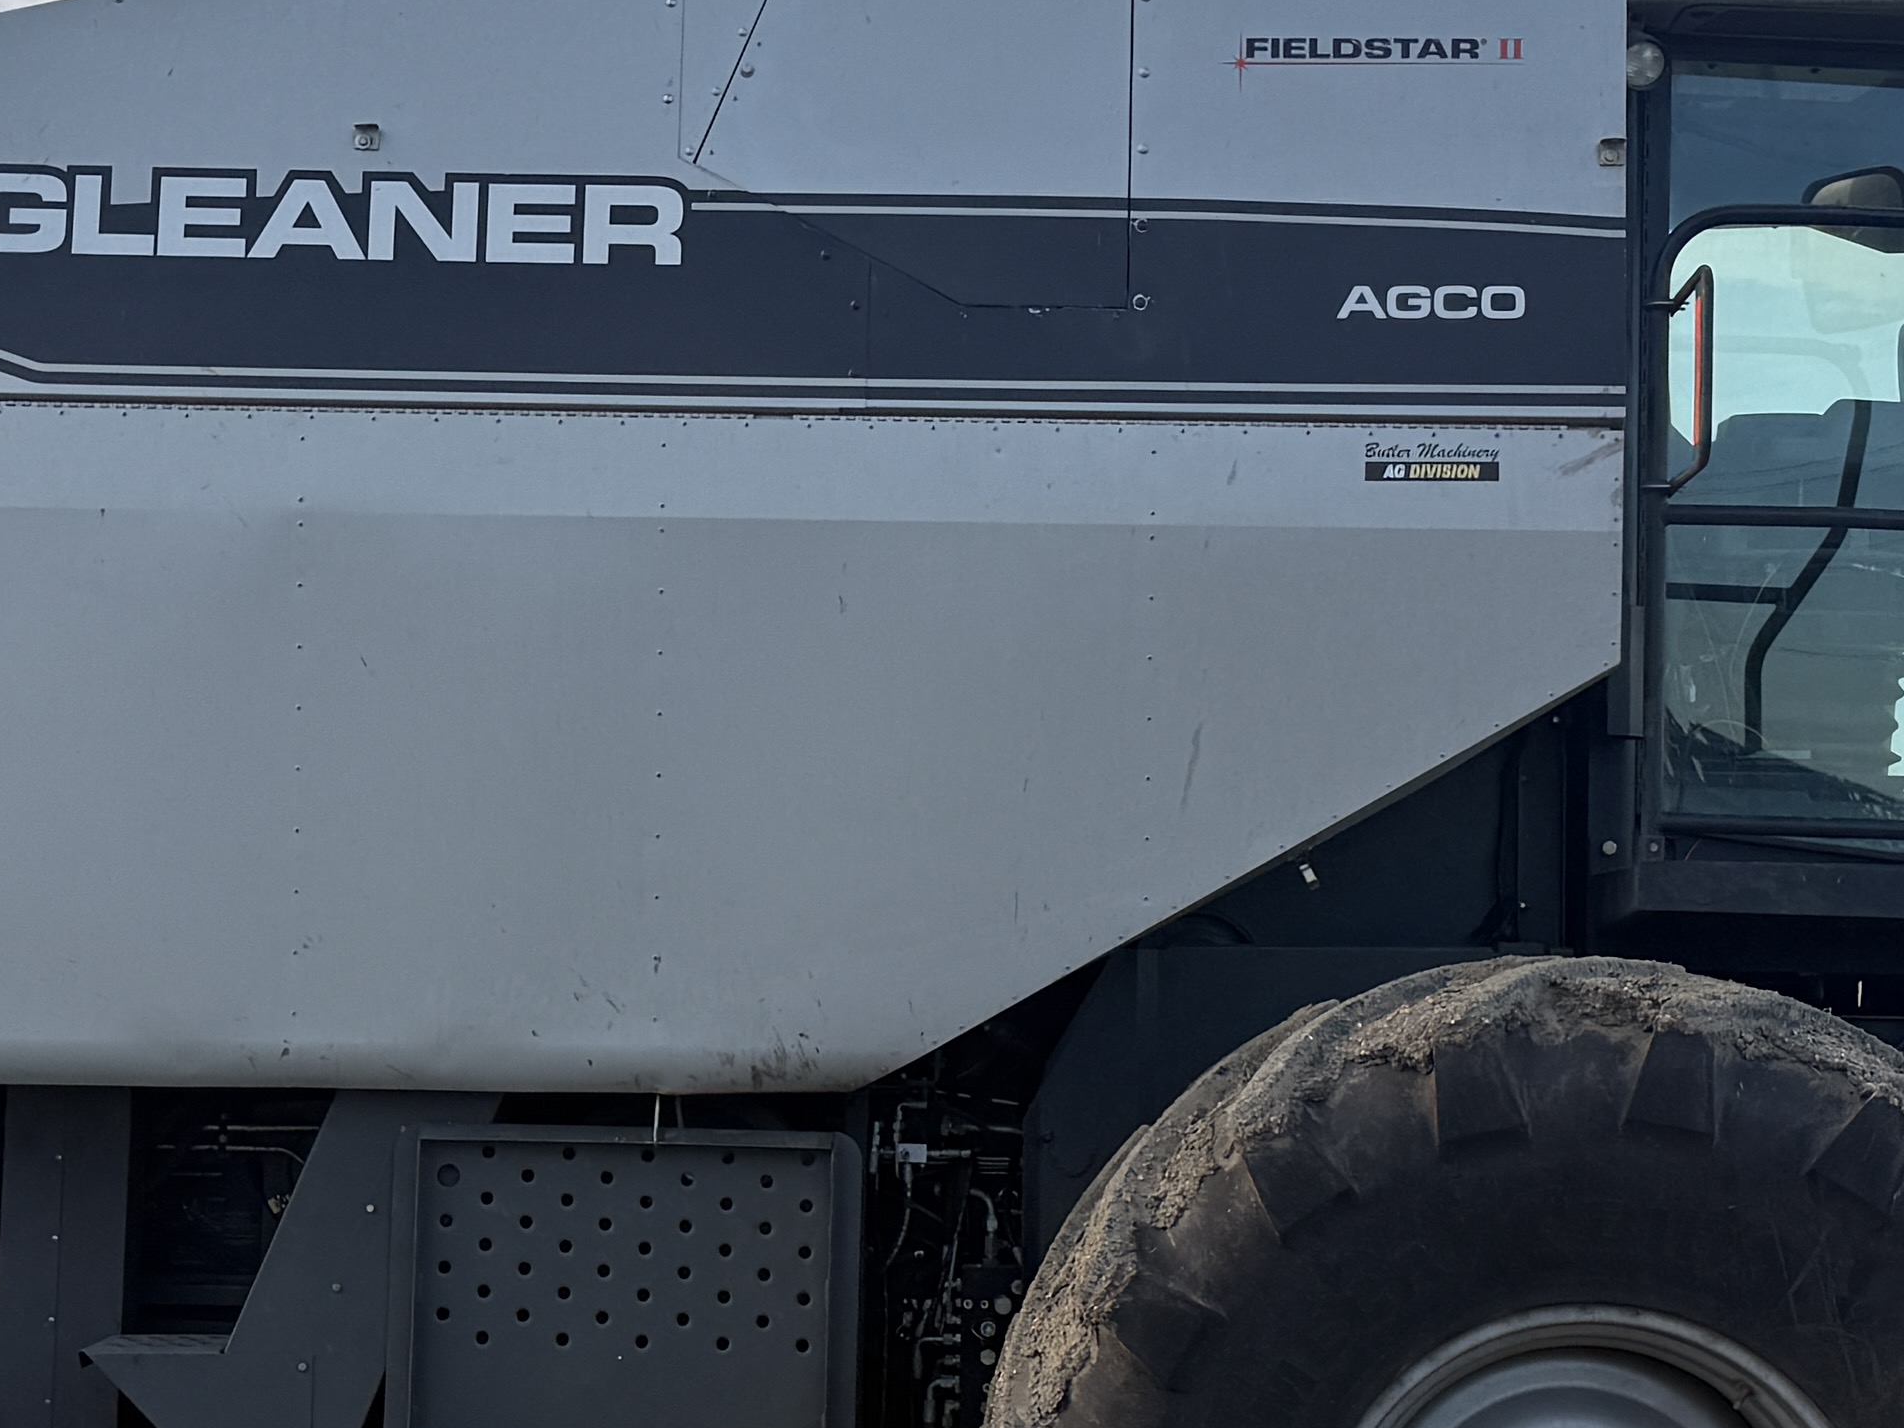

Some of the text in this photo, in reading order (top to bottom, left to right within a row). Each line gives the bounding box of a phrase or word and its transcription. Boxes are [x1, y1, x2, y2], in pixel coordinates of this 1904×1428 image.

[1246, 37, 1524, 60] FIELDSTAR II
[1336, 284, 1526, 320] AGCO
[1364, 442, 1500, 461] Butler Machinery
[1382, 463, 1481, 479] AG DIVISION
